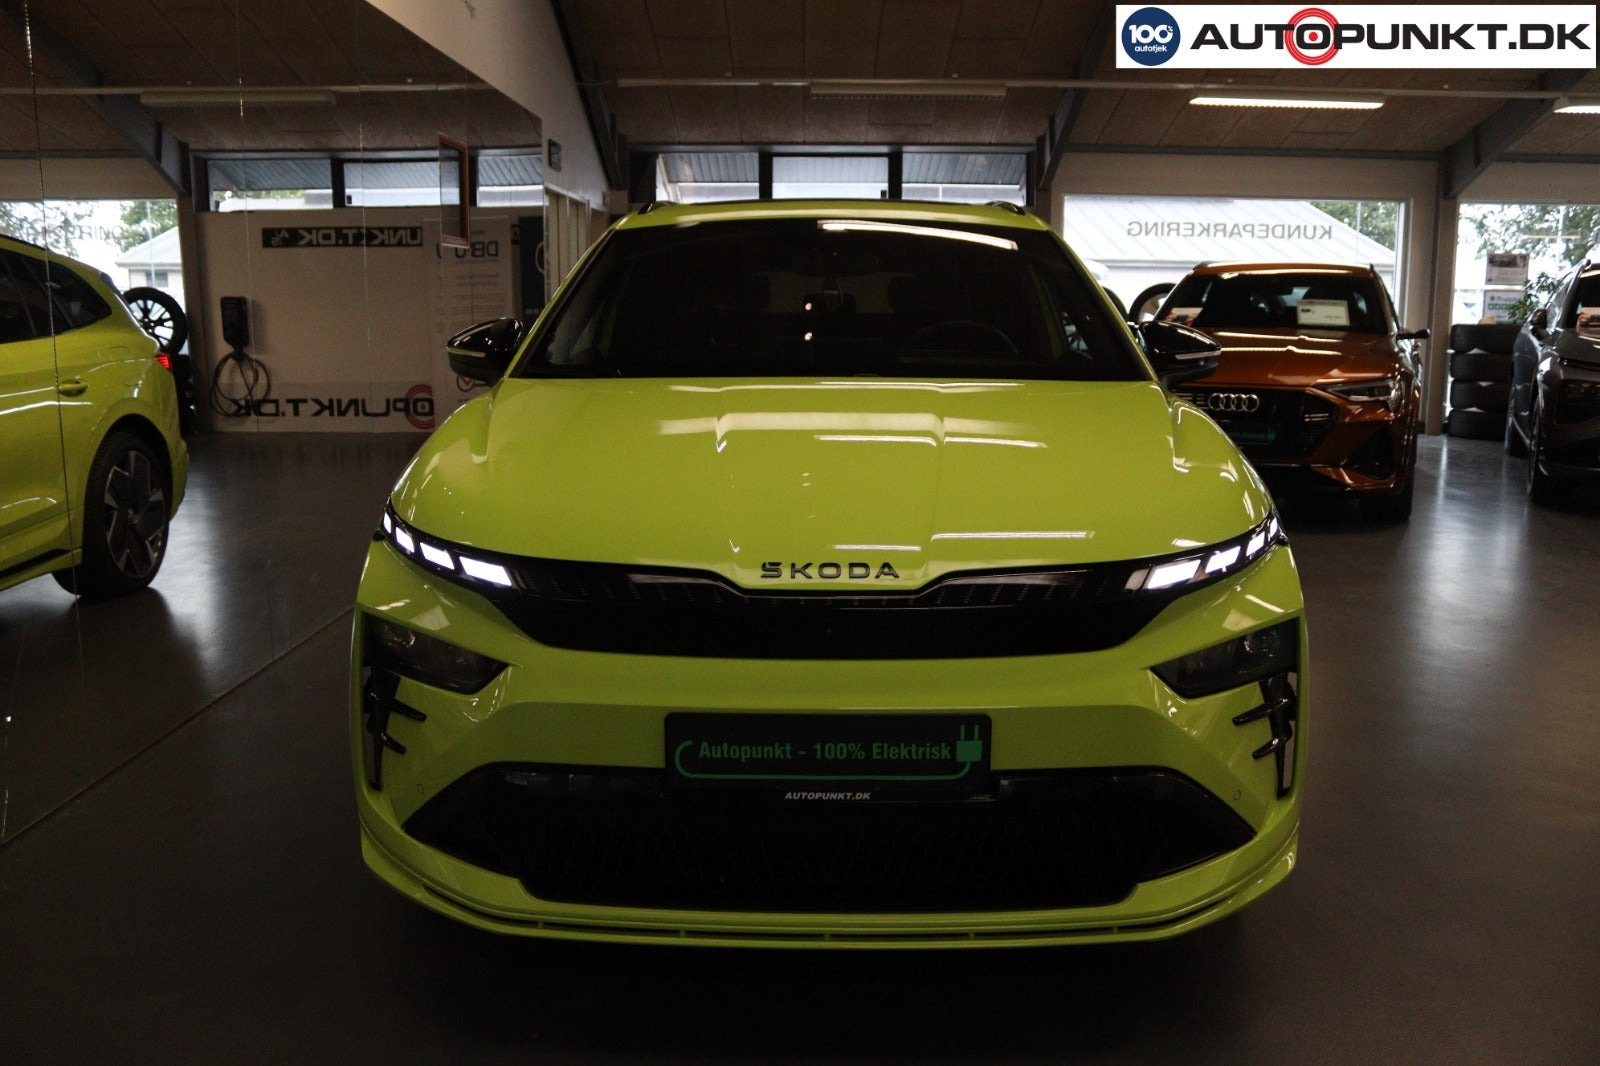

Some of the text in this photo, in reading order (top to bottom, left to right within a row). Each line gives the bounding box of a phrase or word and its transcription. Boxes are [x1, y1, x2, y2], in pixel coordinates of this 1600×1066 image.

[699, 740, 793, 764] Autopunkt
[814, 742, 866, 761] 100%
[871, 741, 952, 761] Elektrisk
[784, 791, 872, 801] AUTOPUNKT.DK
